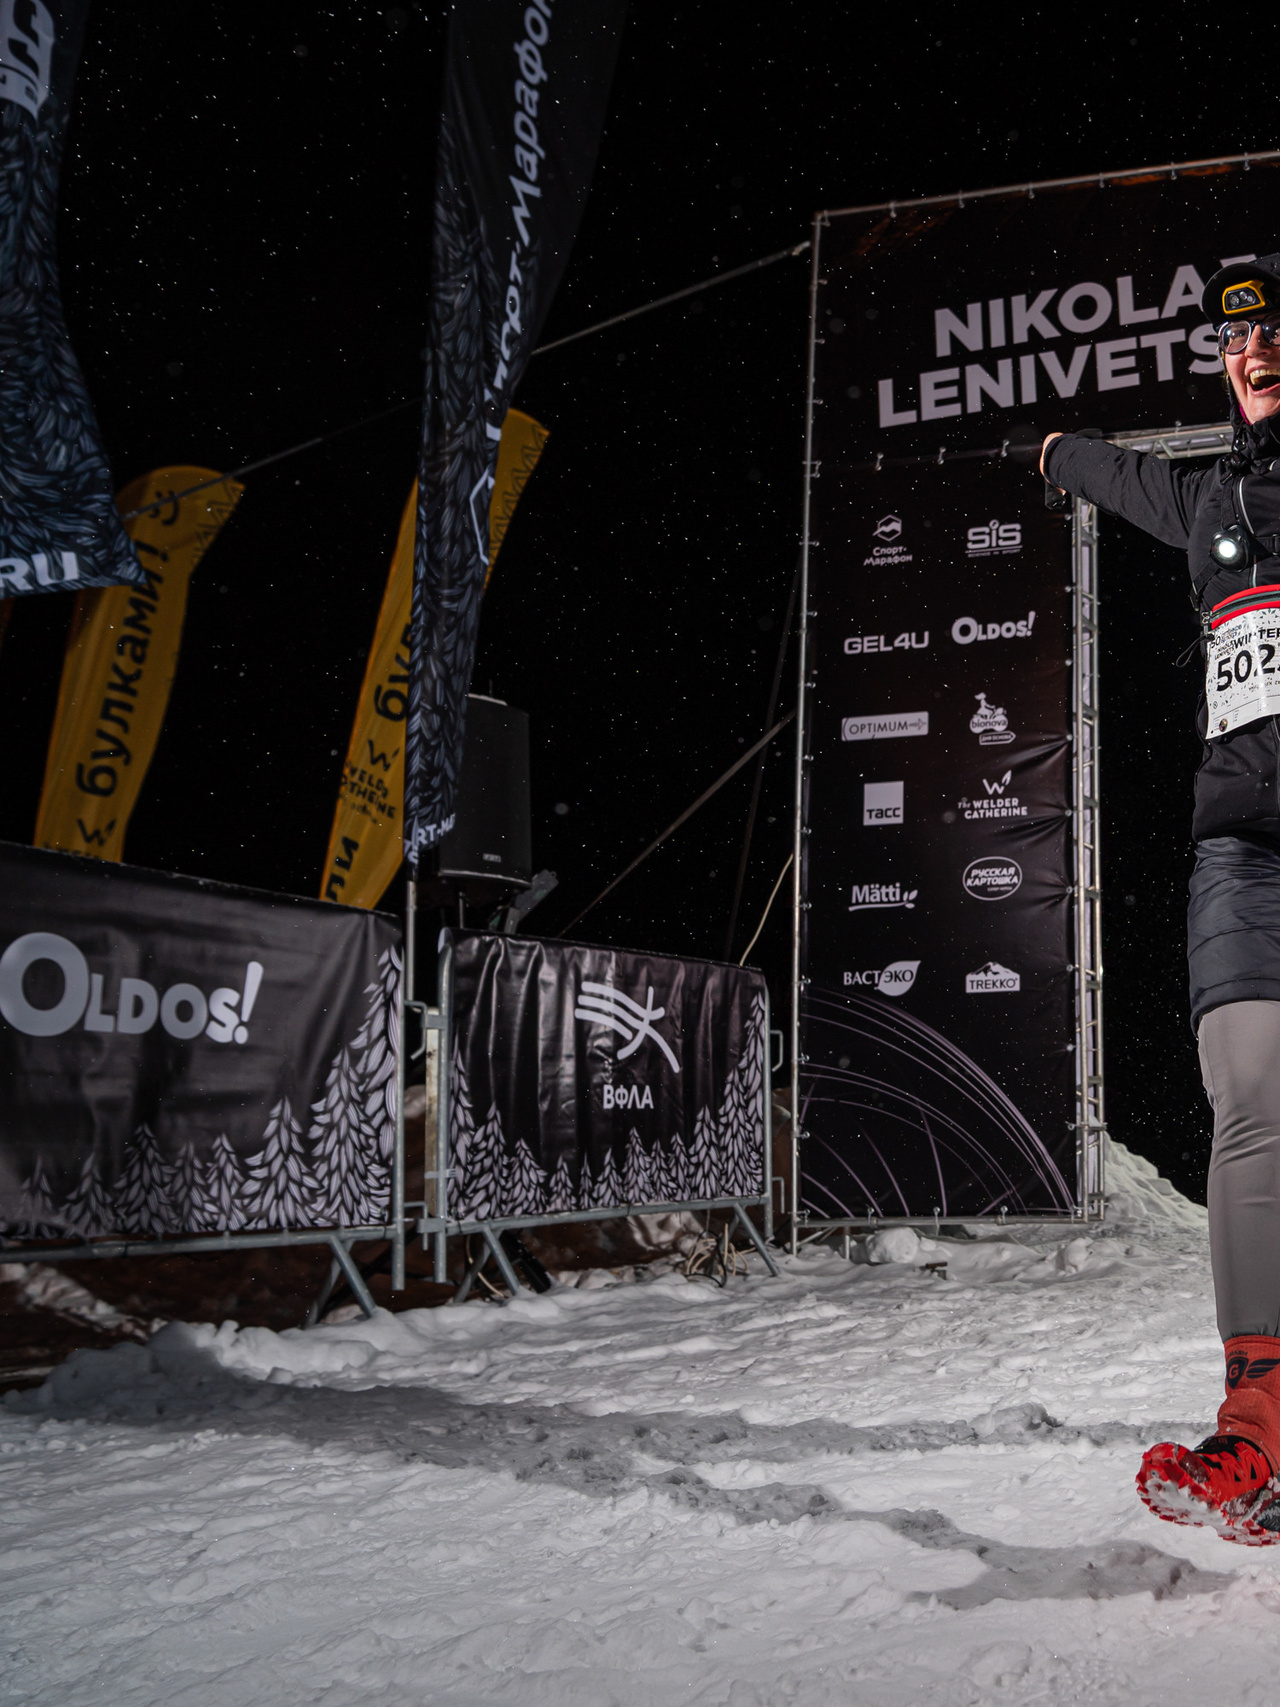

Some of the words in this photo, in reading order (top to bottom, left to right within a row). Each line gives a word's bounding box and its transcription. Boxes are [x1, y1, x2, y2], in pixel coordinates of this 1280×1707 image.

[878, 323, 1224, 428] LENIVETS
[863, 554, 913, 567] Марафон
[844, 630, 930, 655] GEL4U
[849, 720, 908, 735] OPTIMUM
[971, 719, 1007, 729] bionova
[973, 797, 1019, 809] WELDER
[964, 806, 1028, 819] CATHERINE
[971, 866, 1016, 877] РУССКАЯ
[966, 875, 1019, 887] КАРТОШКА
[851, 882, 901, 904] Mätti
[969, 978, 1016, 990] TREKKO
